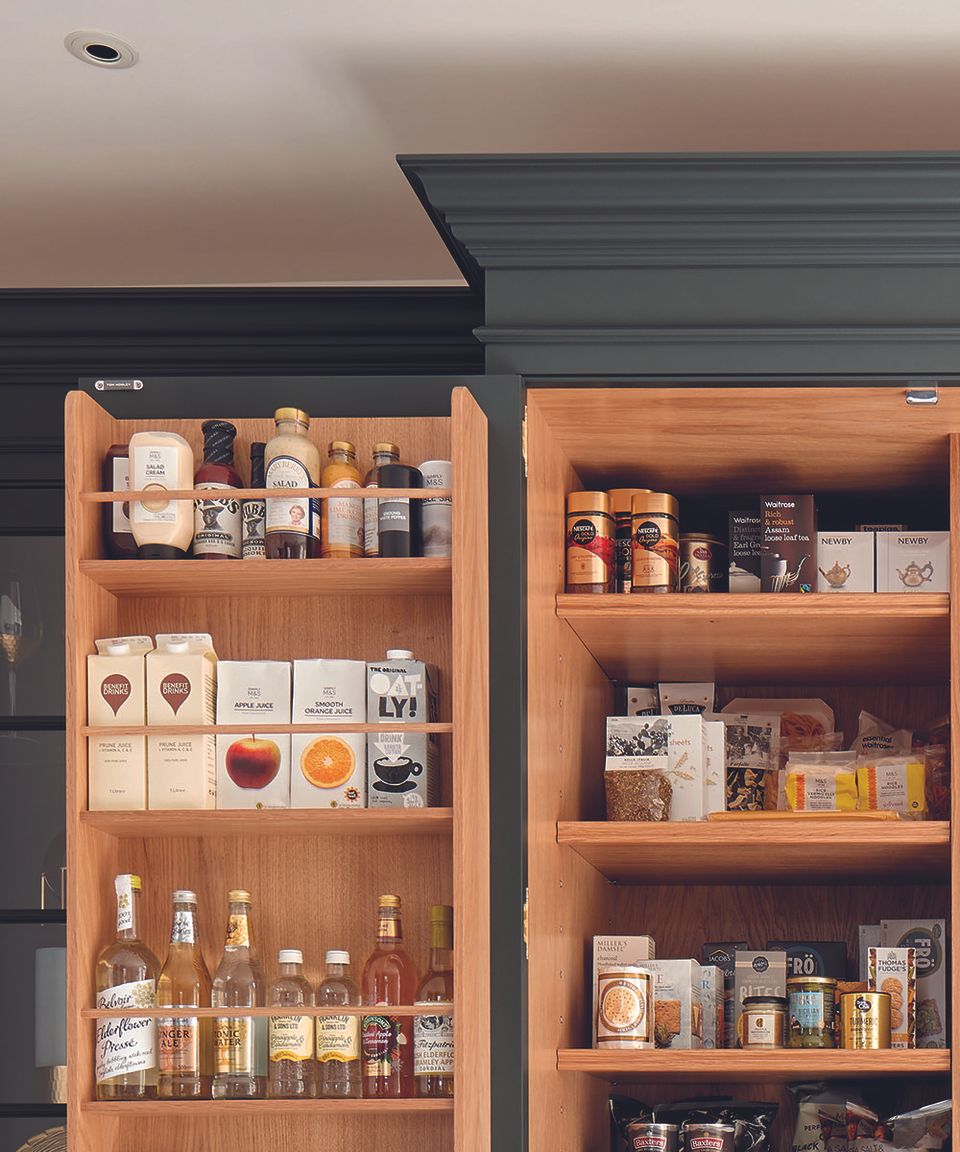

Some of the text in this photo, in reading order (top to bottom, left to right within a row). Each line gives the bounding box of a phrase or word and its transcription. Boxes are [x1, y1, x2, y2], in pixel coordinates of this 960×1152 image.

[370, 674, 423, 696] OAT-
[379, 697, 417, 718] LY!
[99, 991, 133, 1009] Belvoir
[161, 1040, 179, 1048] ALE
[635, 1140, 665, 1148] Baxters
[692, 1140, 722, 1148] Baxters
